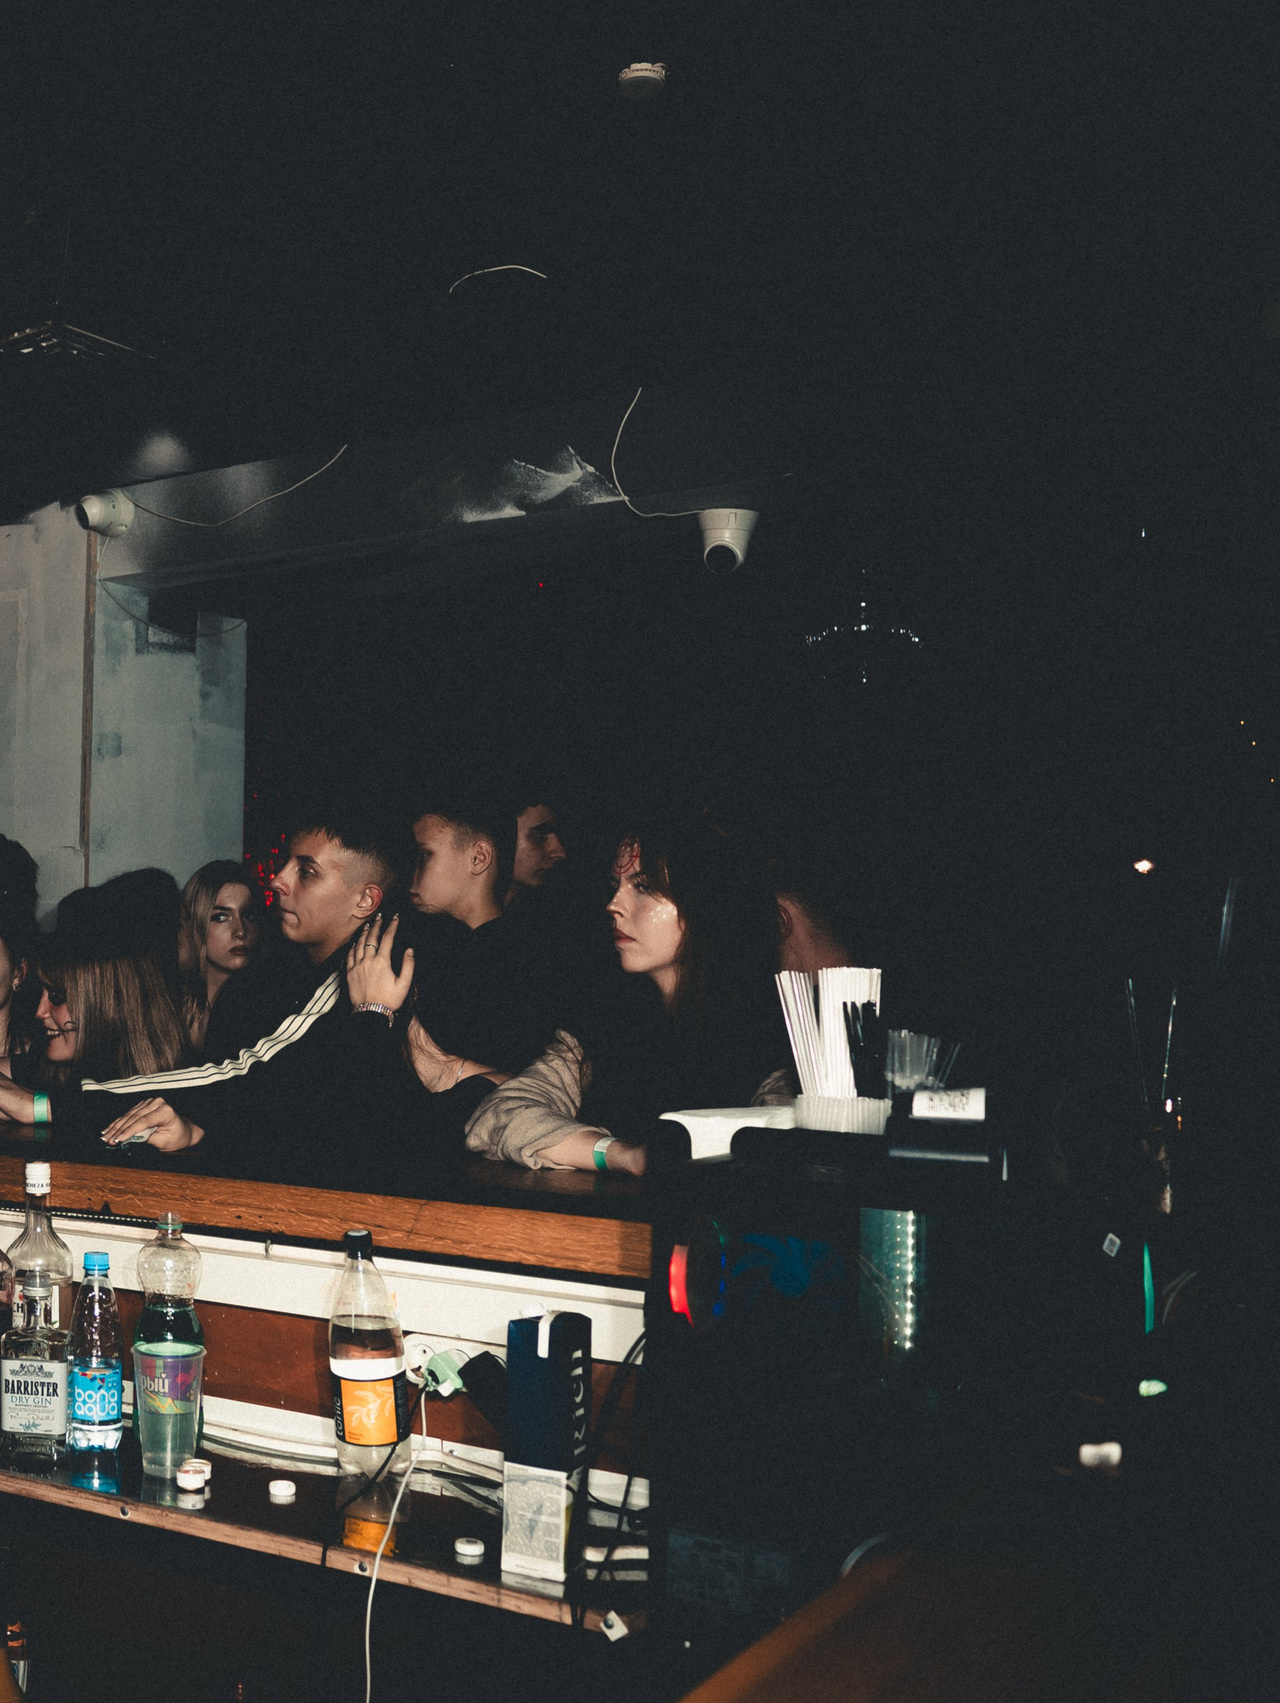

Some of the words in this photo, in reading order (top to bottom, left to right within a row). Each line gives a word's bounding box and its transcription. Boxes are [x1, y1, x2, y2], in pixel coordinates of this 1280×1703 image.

[4, 1379, 59, 1397] BARRISTER
[10, 1395, 30, 1404] DRY
[33, 1397, 52, 1405] GIN
